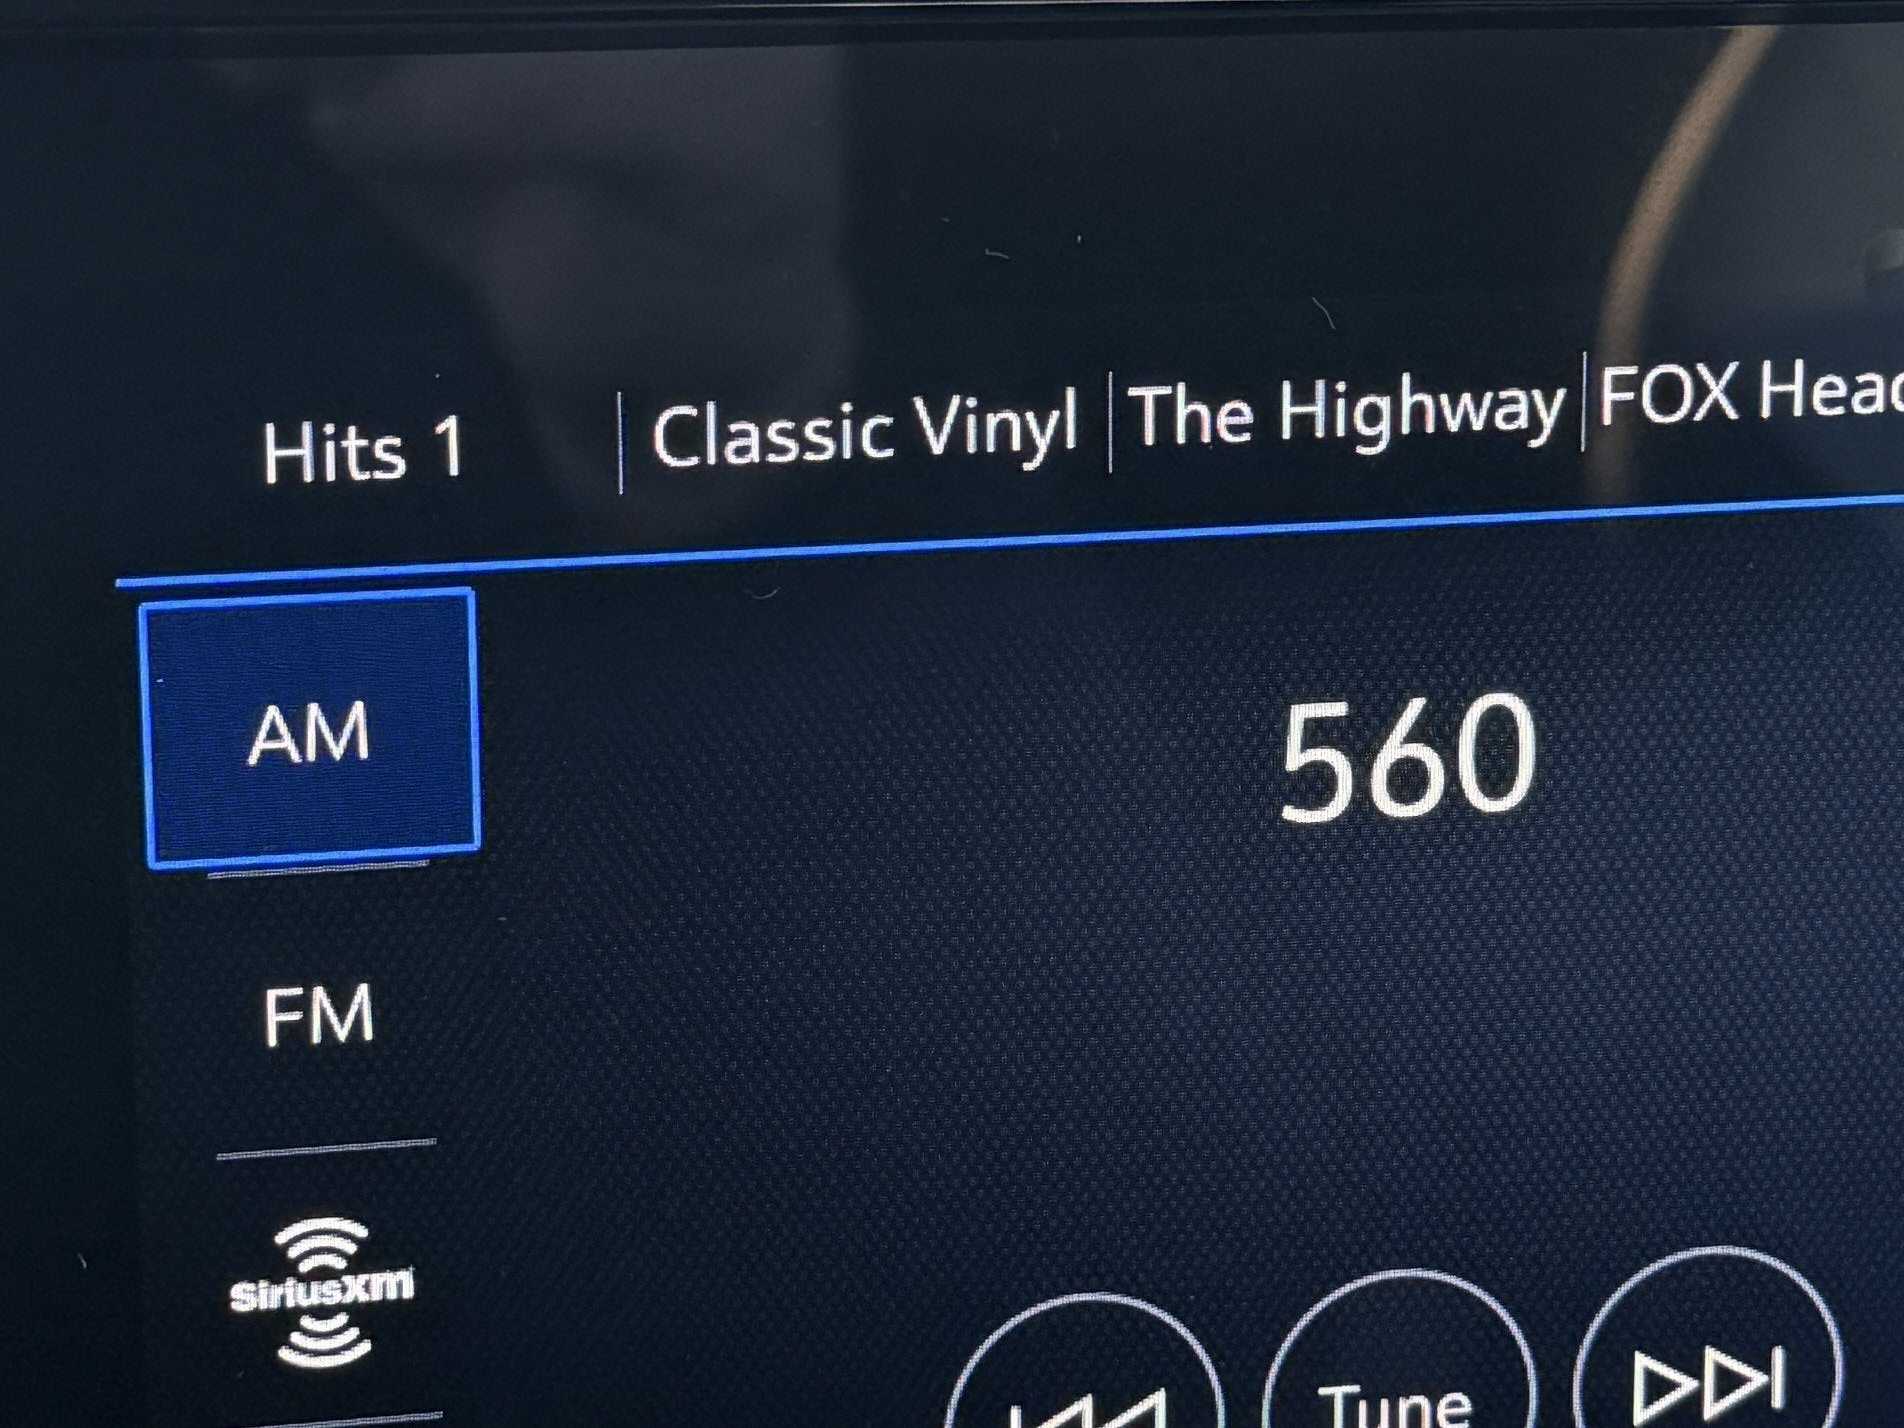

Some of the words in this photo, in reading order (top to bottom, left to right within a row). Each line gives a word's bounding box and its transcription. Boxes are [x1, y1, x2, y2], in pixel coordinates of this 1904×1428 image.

[652, 399, 895, 470] Classic
[913, 386, 1077, 472] Vinyl
[1127, 381, 1253, 447] The
[1280, 372, 1567, 456] Highway
[1601, 361, 1741, 427] FOX
[263, 417, 408, 484] Hits
[433, 414, 463, 478] 1
[247, 699, 372, 767] AM
[1280, 691, 1538, 825] 560
[265, 982, 375, 1049] FM
